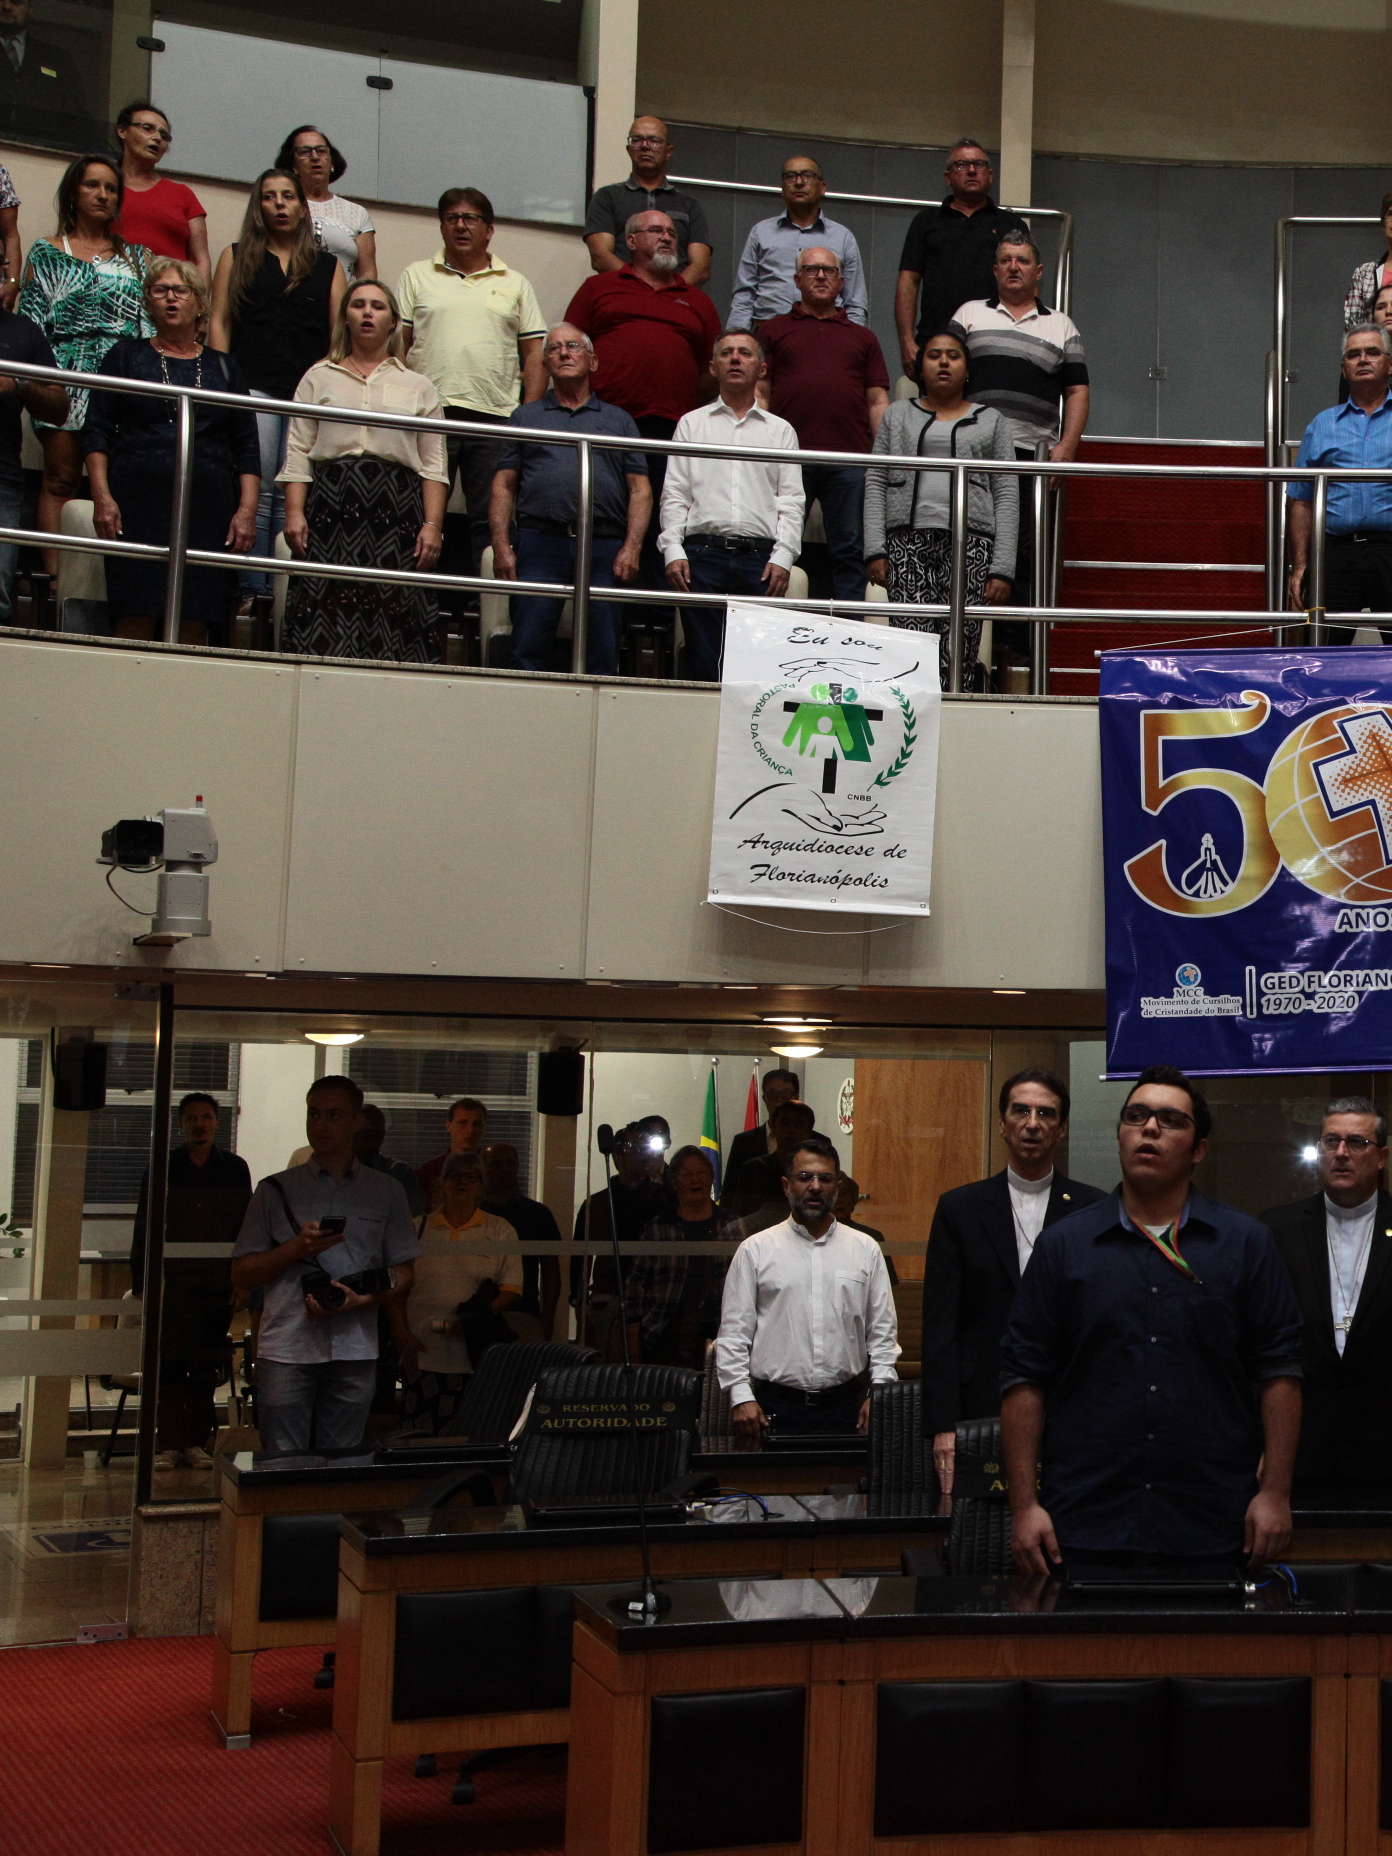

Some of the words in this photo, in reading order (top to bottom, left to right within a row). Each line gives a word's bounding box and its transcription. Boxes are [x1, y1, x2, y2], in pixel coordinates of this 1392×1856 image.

[787, 626, 829, 646] Eu
[840, 635, 884, 651] sou
[751, 682, 796, 720] PASTORAL
[750, 723, 759, 740] DA
[753, 741, 793, 777] CRIANÇA
[847, 793, 872, 802] CNBB
[737, 832, 875, 858] Arquidiocese
[882, 843, 908, 859] de
[749, 863, 890, 890] Florianópolis
[1263, 975, 1301, 990] GED
[1175, 989, 1202, 997] MCC
[1143, 998, 1189, 1006] Movimento
[1202, 997, 1241, 1005] Cursilhos
[1264, 996, 1303, 1011] 1970
[1316, 995, 1356, 1010] 2020
[1143, 1008, 1153, 1016] de
[1155, 1007, 1203, 1016] Cristandade
[1217, 1006, 1240, 1014] Brasil
